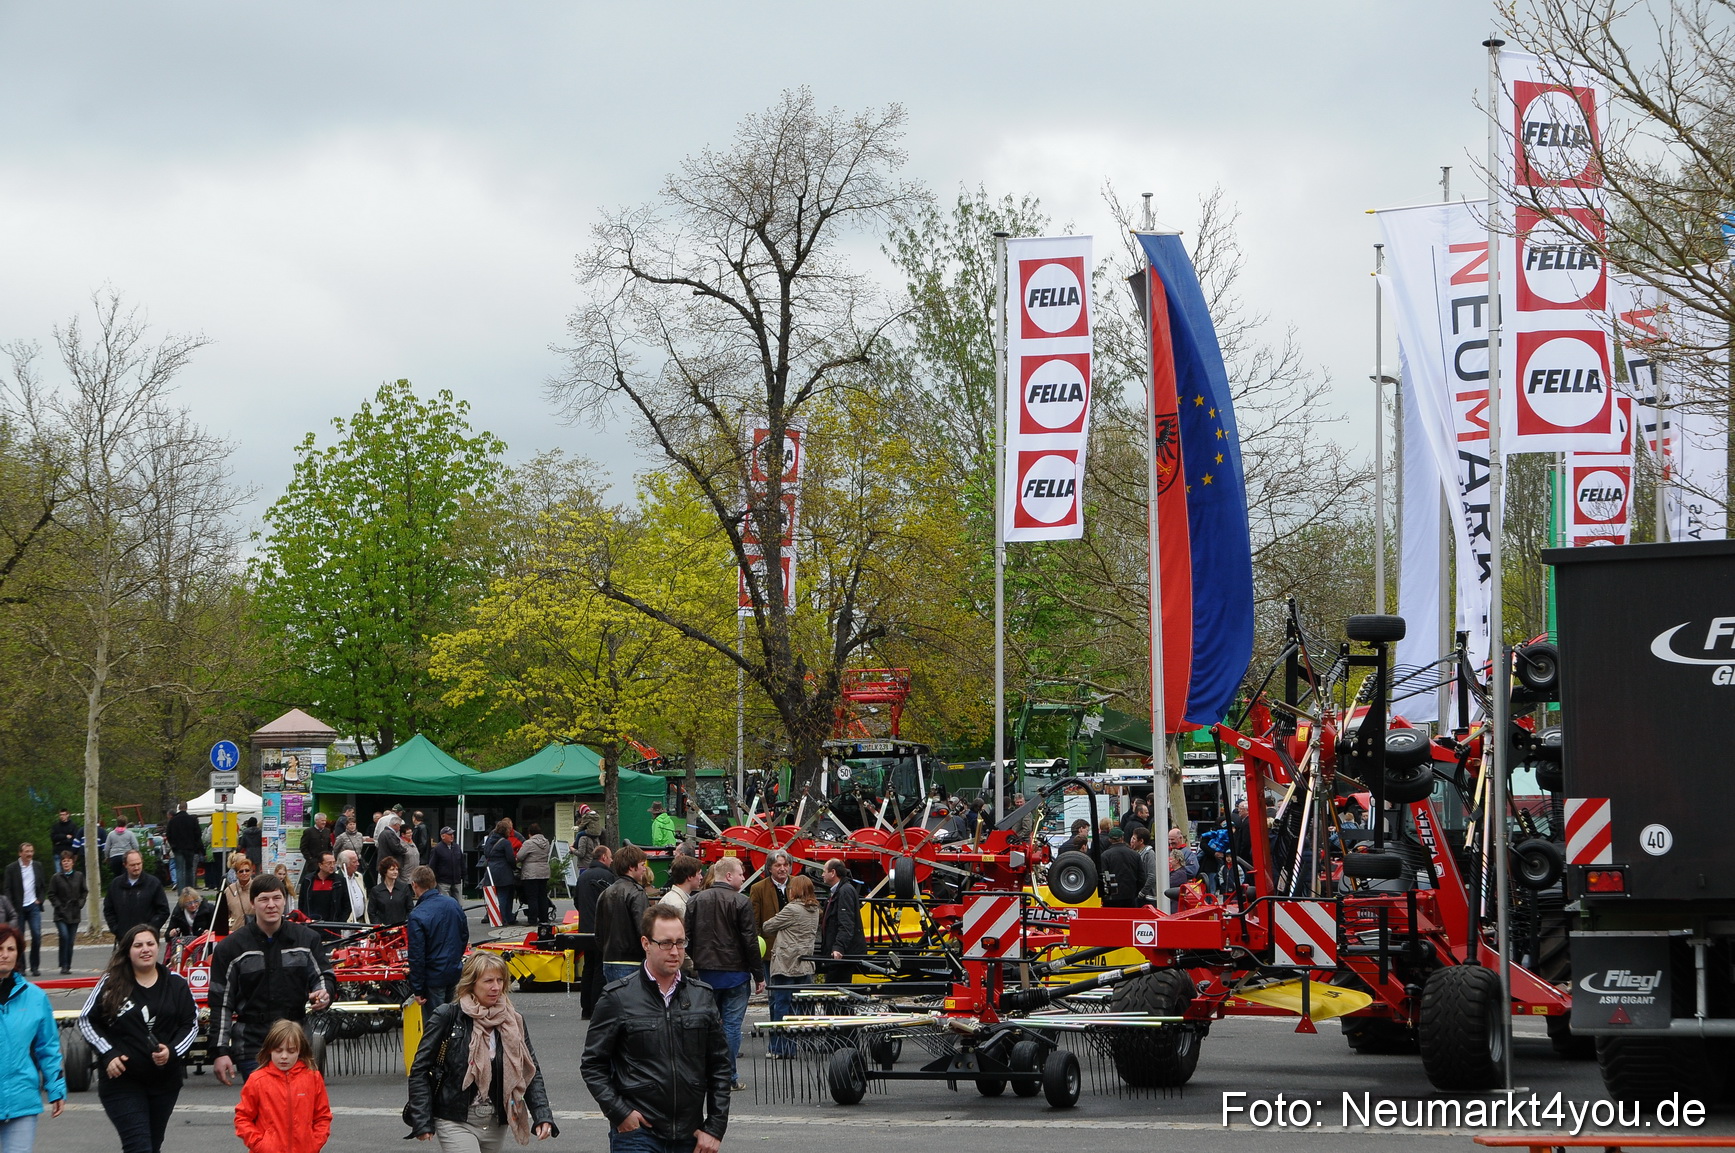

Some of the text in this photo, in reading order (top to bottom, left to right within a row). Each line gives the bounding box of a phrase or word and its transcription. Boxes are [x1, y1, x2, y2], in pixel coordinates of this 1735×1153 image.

[1524, 121, 1592, 149] FELLA
[1525, 246, 1598, 271] FELLA
[1028, 286, 1080, 308] FELLA
[1528, 369, 1603, 394] FELLA
[1028, 383, 1084, 404] FELLA
[1023, 478, 1076, 498] FELLA
[1579, 488, 1623, 502] FELLA
[840, 768, 849, 778] 50
[1647, 831, 1665, 849] 40
[1603, 969, 1663, 991] Fliegl
[1599, 995, 1656, 1005] ASW GIGANT
